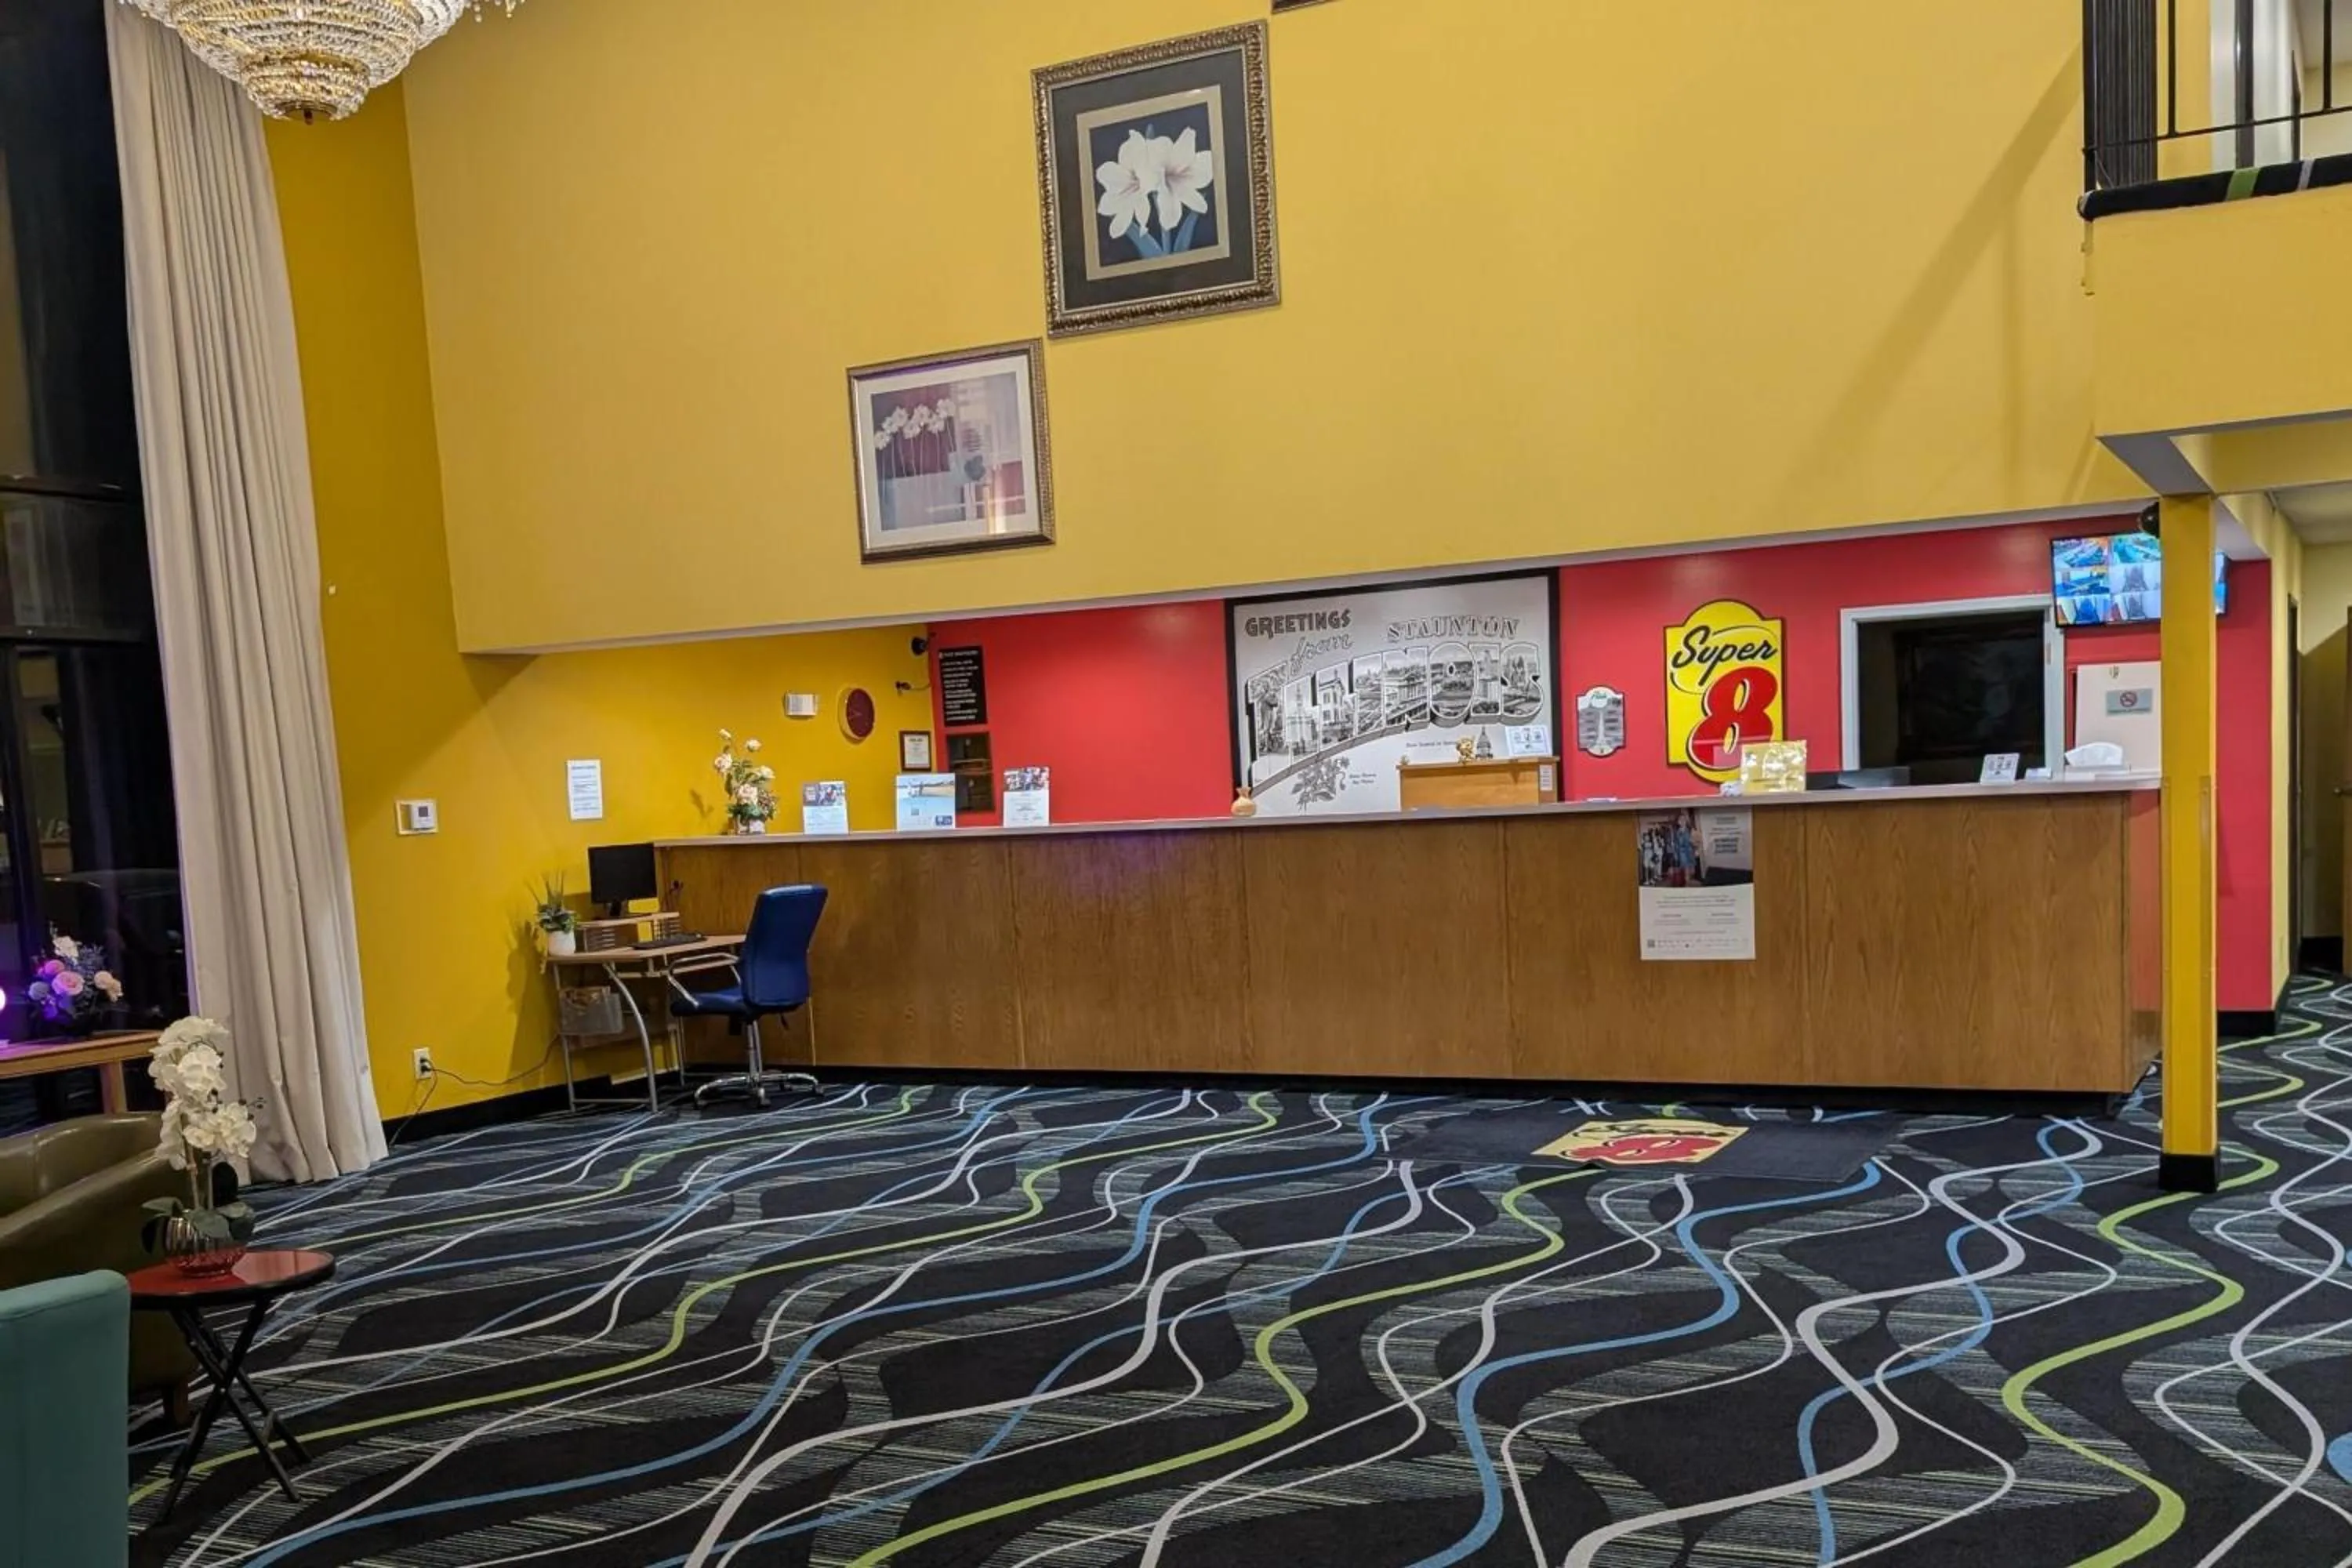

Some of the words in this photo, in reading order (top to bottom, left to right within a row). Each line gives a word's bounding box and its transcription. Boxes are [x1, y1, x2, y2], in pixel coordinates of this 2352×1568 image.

[1245, 608, 1352, 638] GREETINGS
[1386, 615, 1519, 643] STAUNTON
[1290, 632, 1353, 673] from
[1671, 625, 1778, 687] Super
[1246, 641, 1544, 789] ILLINOIS
[1686, 666, 1778, 771] 8
